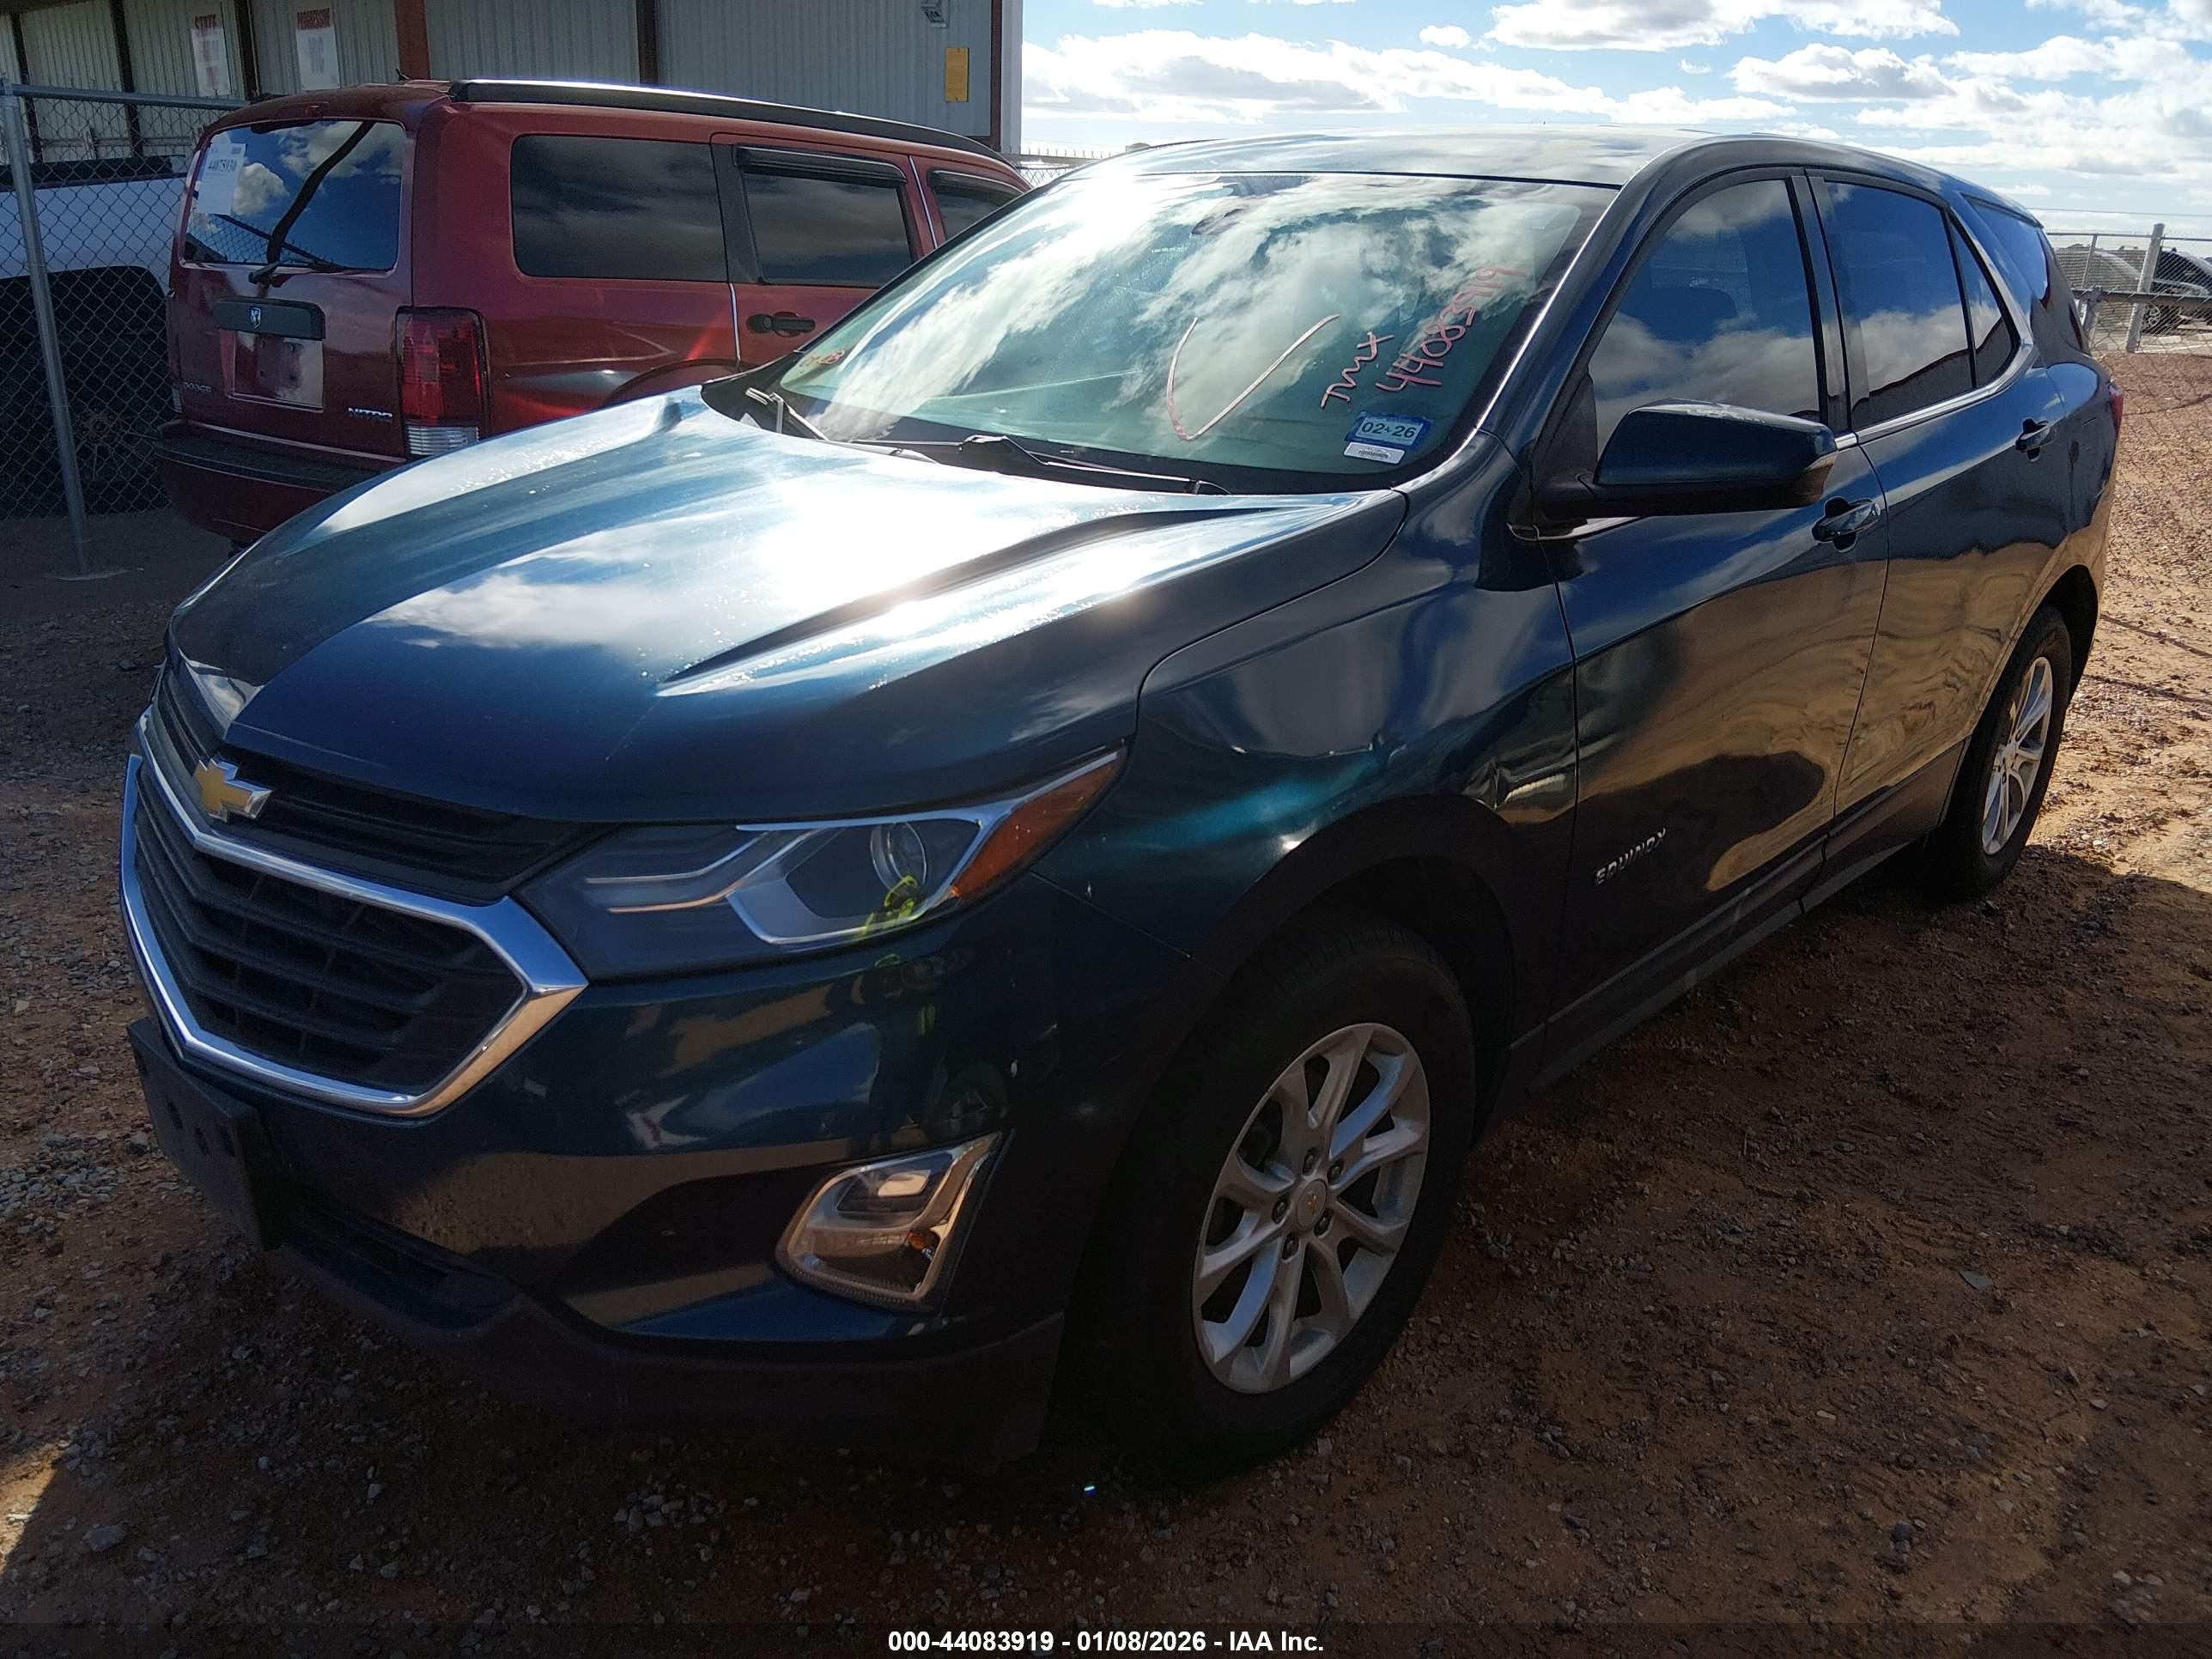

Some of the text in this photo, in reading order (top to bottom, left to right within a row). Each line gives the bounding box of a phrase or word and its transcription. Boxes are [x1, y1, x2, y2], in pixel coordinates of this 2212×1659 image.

[182, 381, 212, 392] DODGE
[348, 406, 393, 422] NITRO
[1595, 827, 1666, 885] EQUINOX
